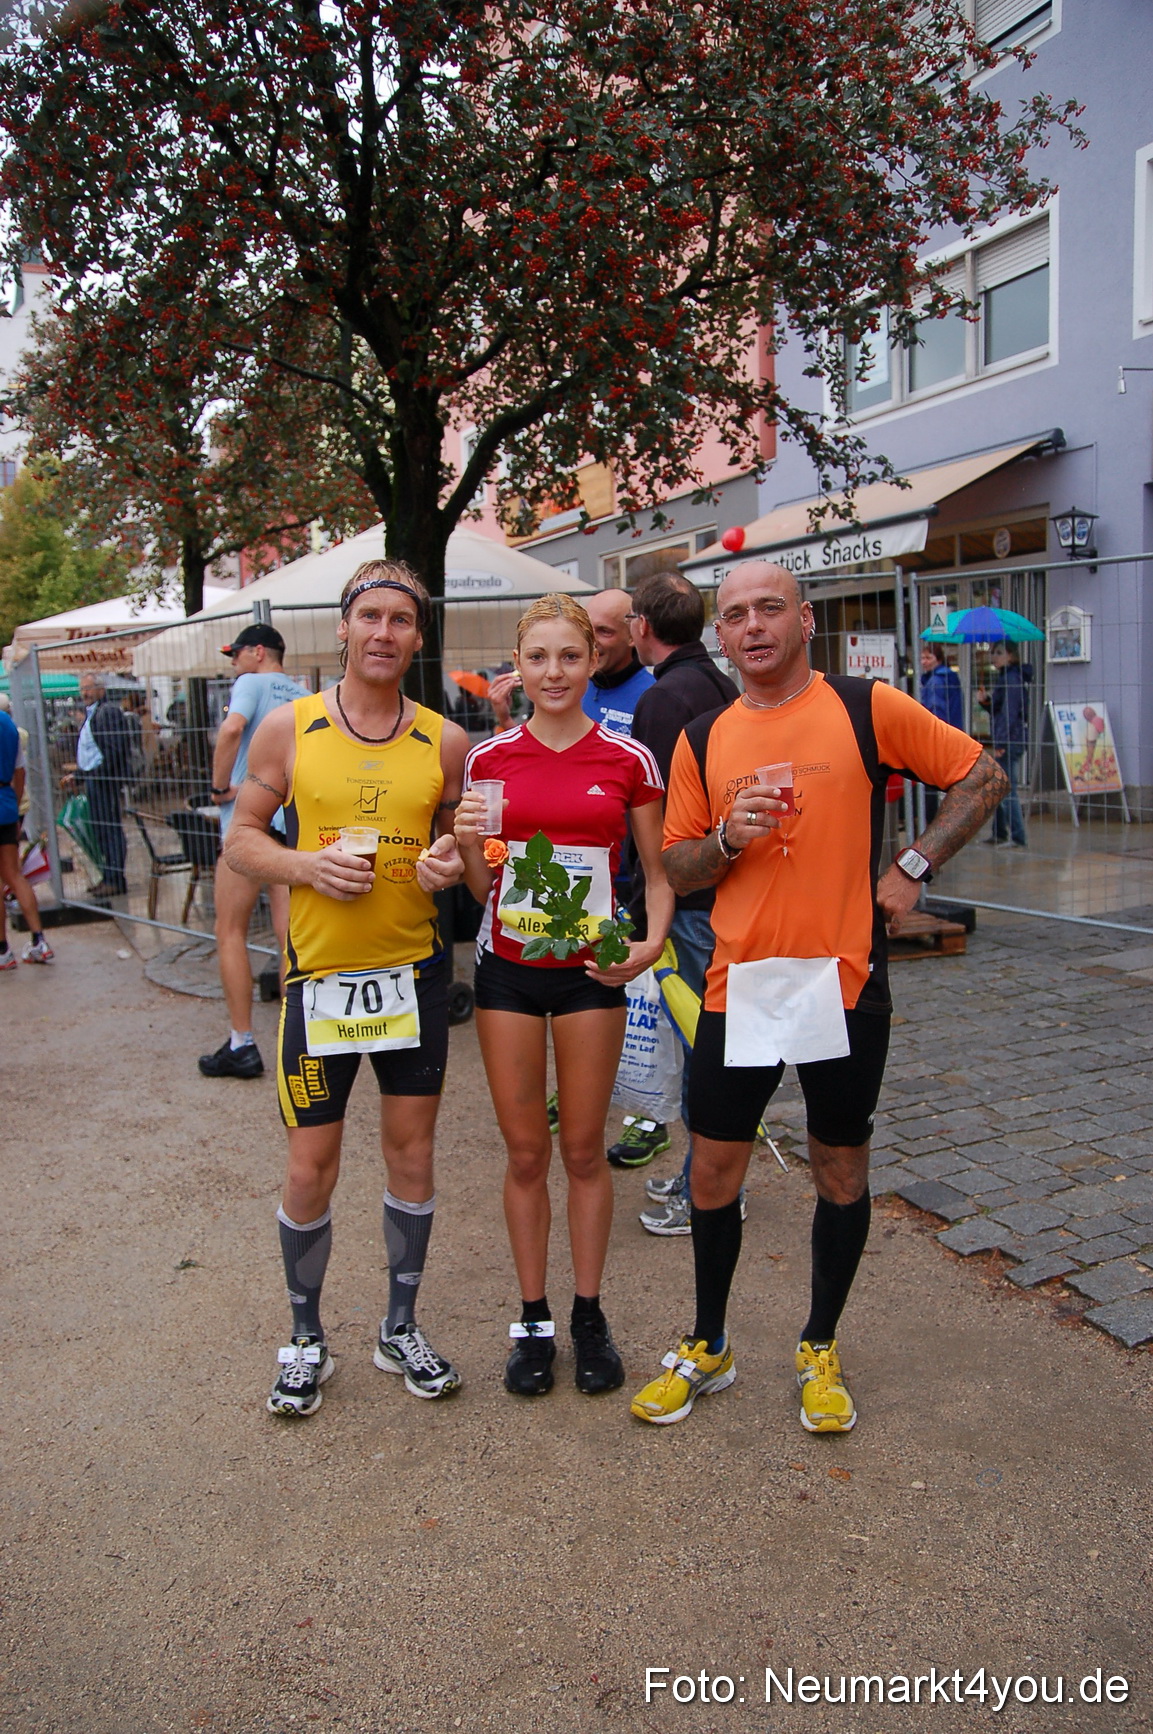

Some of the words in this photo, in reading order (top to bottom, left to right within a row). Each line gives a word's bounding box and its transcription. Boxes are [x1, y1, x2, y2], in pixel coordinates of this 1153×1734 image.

[822, 538, 882, 566] Snacks
[445, 575, 502, 588] egafredo
[798, 765, 831, 775] SCHMUCK
[354, 814, 387, 822] NEUMARKT
[391, 868, 414, 878] ELIO
[338, 979, 384, 1016] 70
[336, 1021, 389, 1039] Helmut
[303, 1059, 326, 1097] Run!
[294, 1078, 307, 1106] Team
